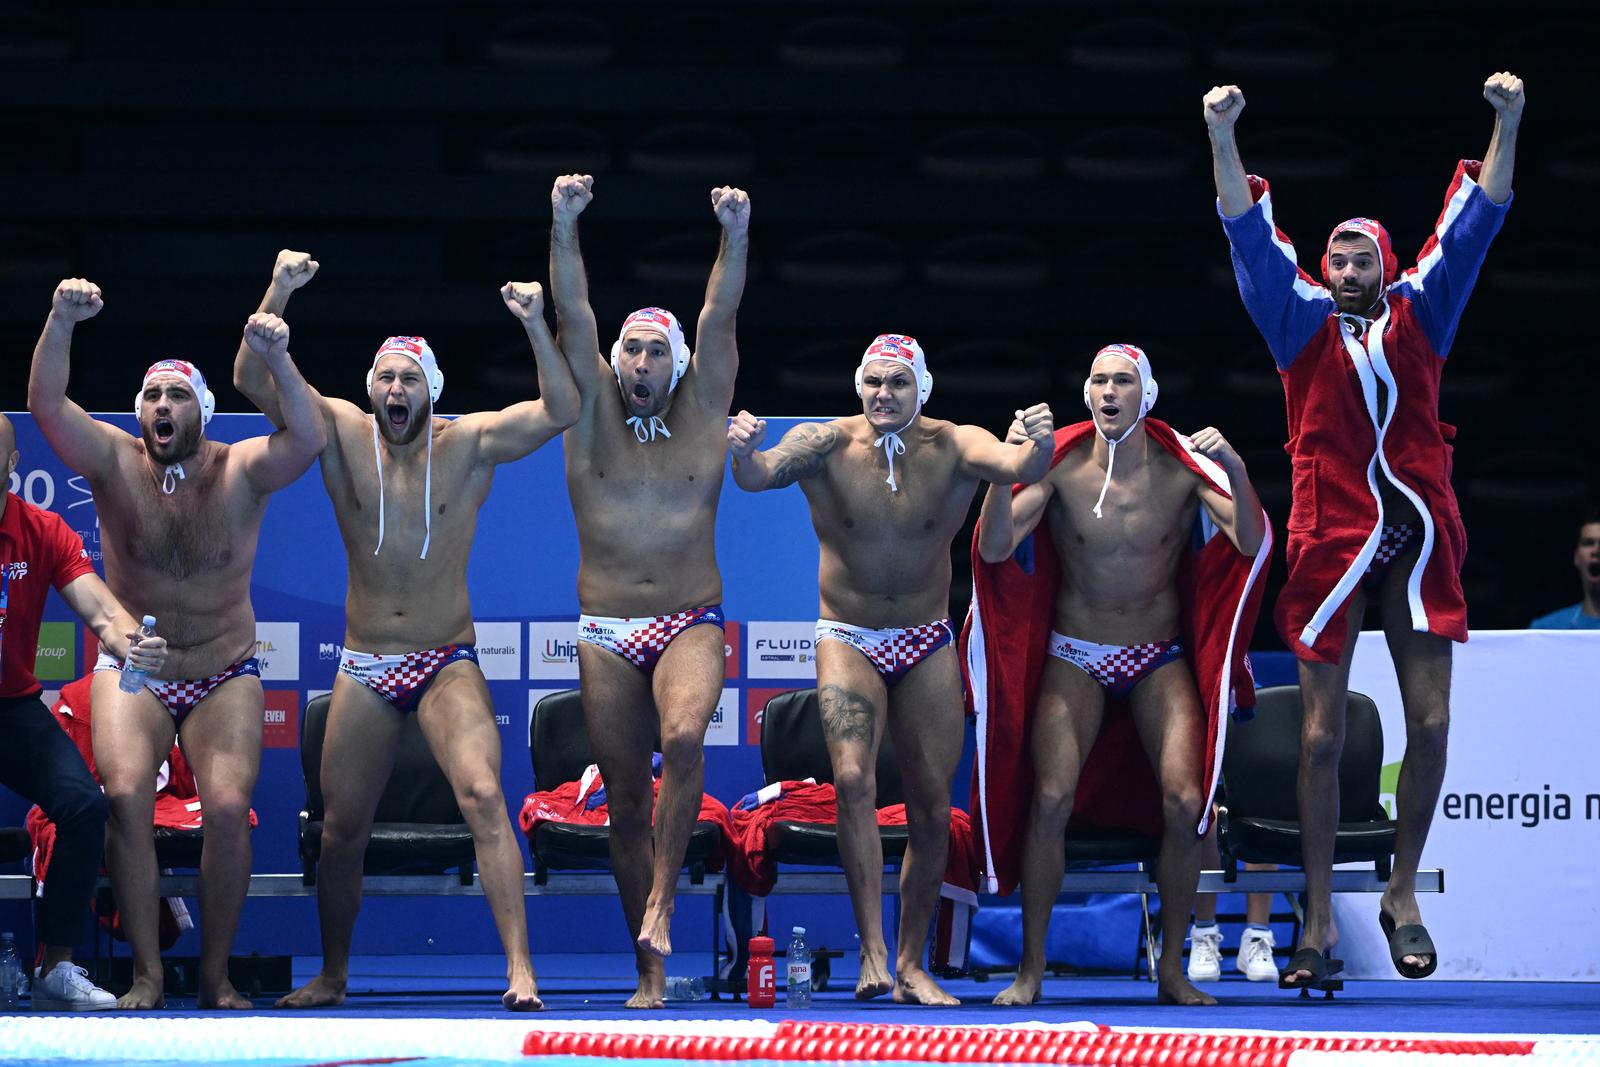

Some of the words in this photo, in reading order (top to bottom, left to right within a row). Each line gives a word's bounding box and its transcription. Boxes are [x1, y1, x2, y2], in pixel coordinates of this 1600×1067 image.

[756, 639, 817, 650] FLUID
[481, 646, 516, 655] naturalis
[1443, 784, 1571, 828] energia
